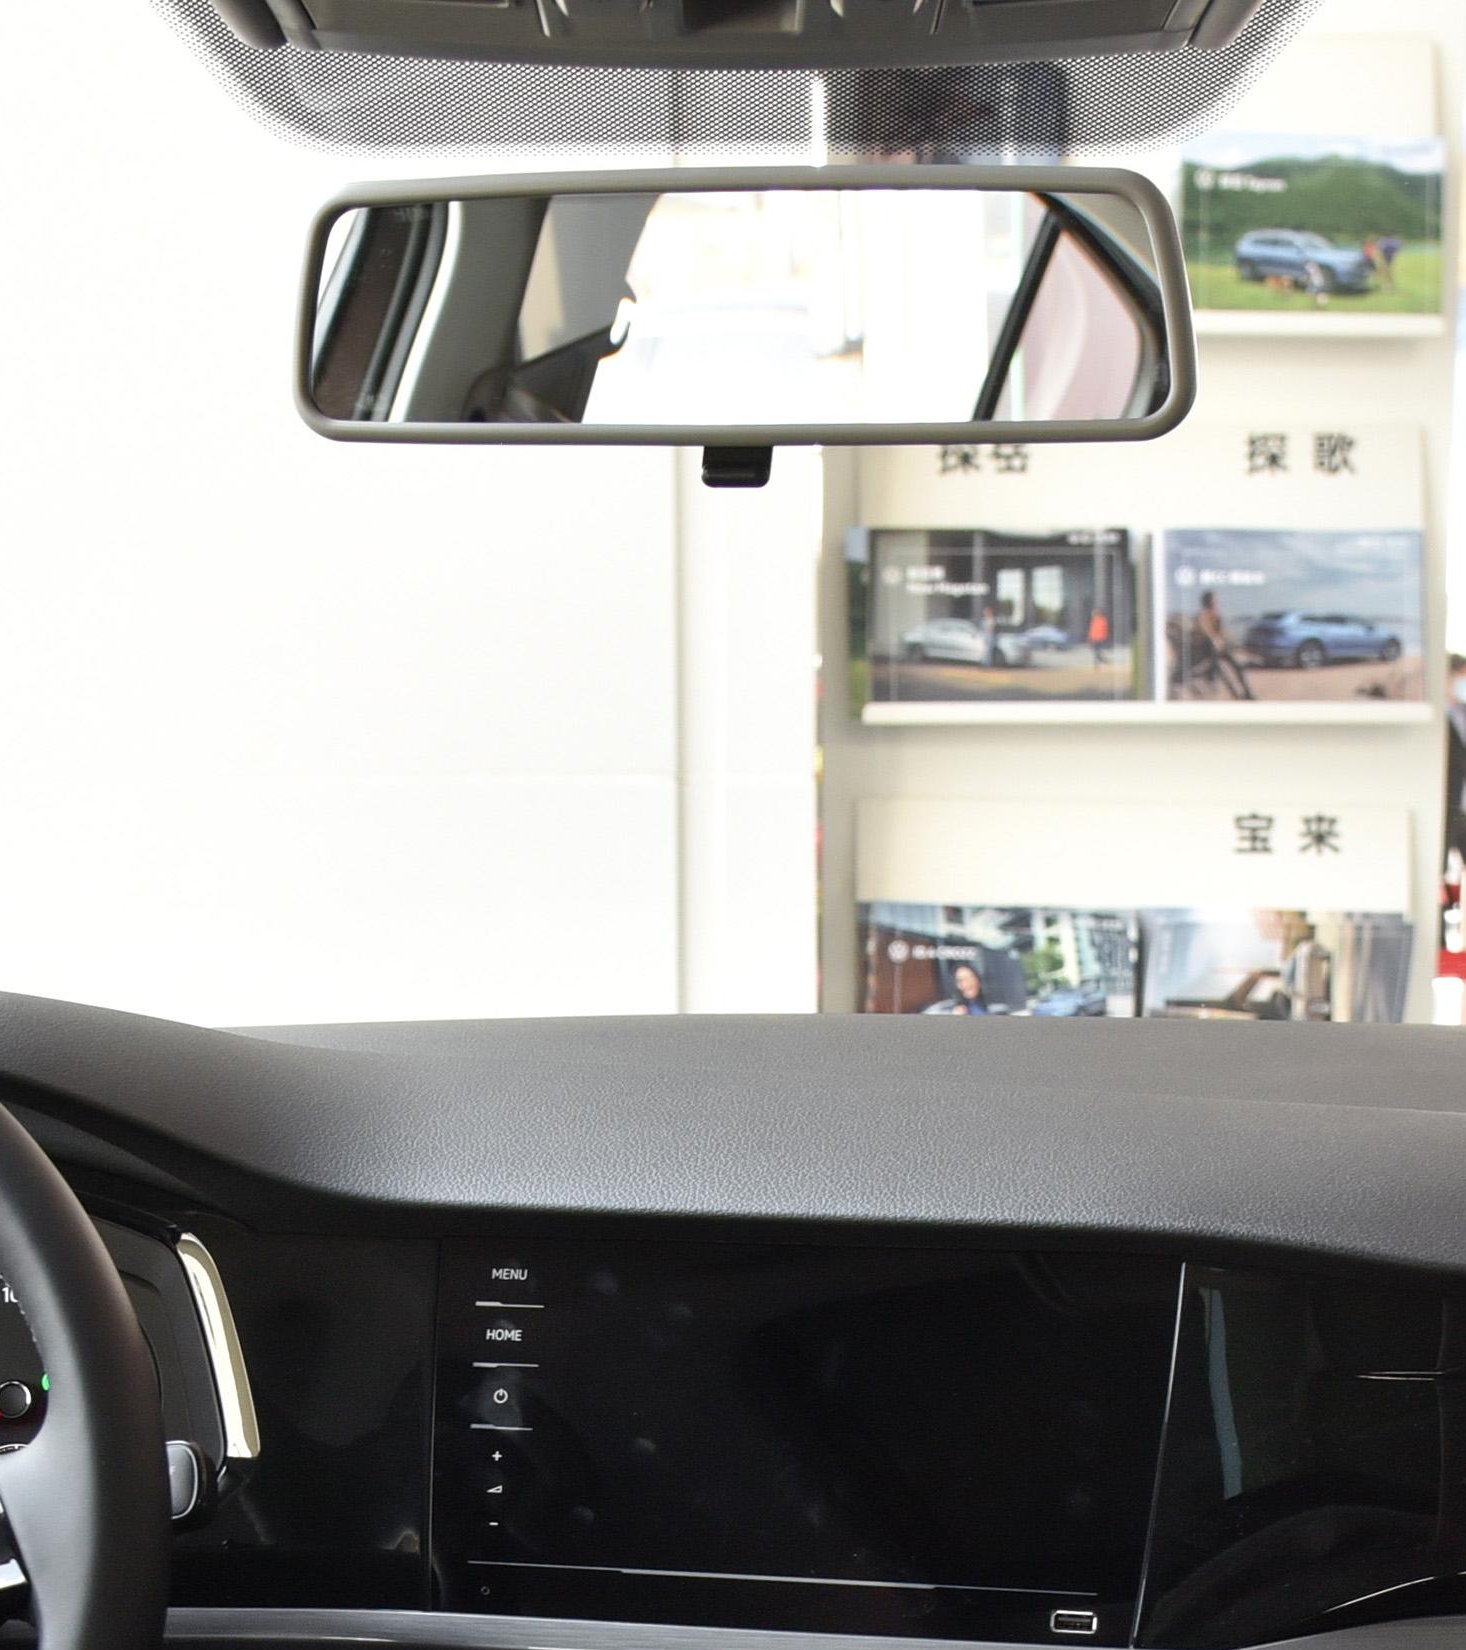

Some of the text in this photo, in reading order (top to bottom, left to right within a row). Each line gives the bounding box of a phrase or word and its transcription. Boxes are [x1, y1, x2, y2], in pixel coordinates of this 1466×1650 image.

[1247, 432, 1358, 475] 探歌
[1233, 813, 1341, 855] 宝来
[492, 1268, 528, 1280] MENU
[486, 1328, 523, 1341] HOME
